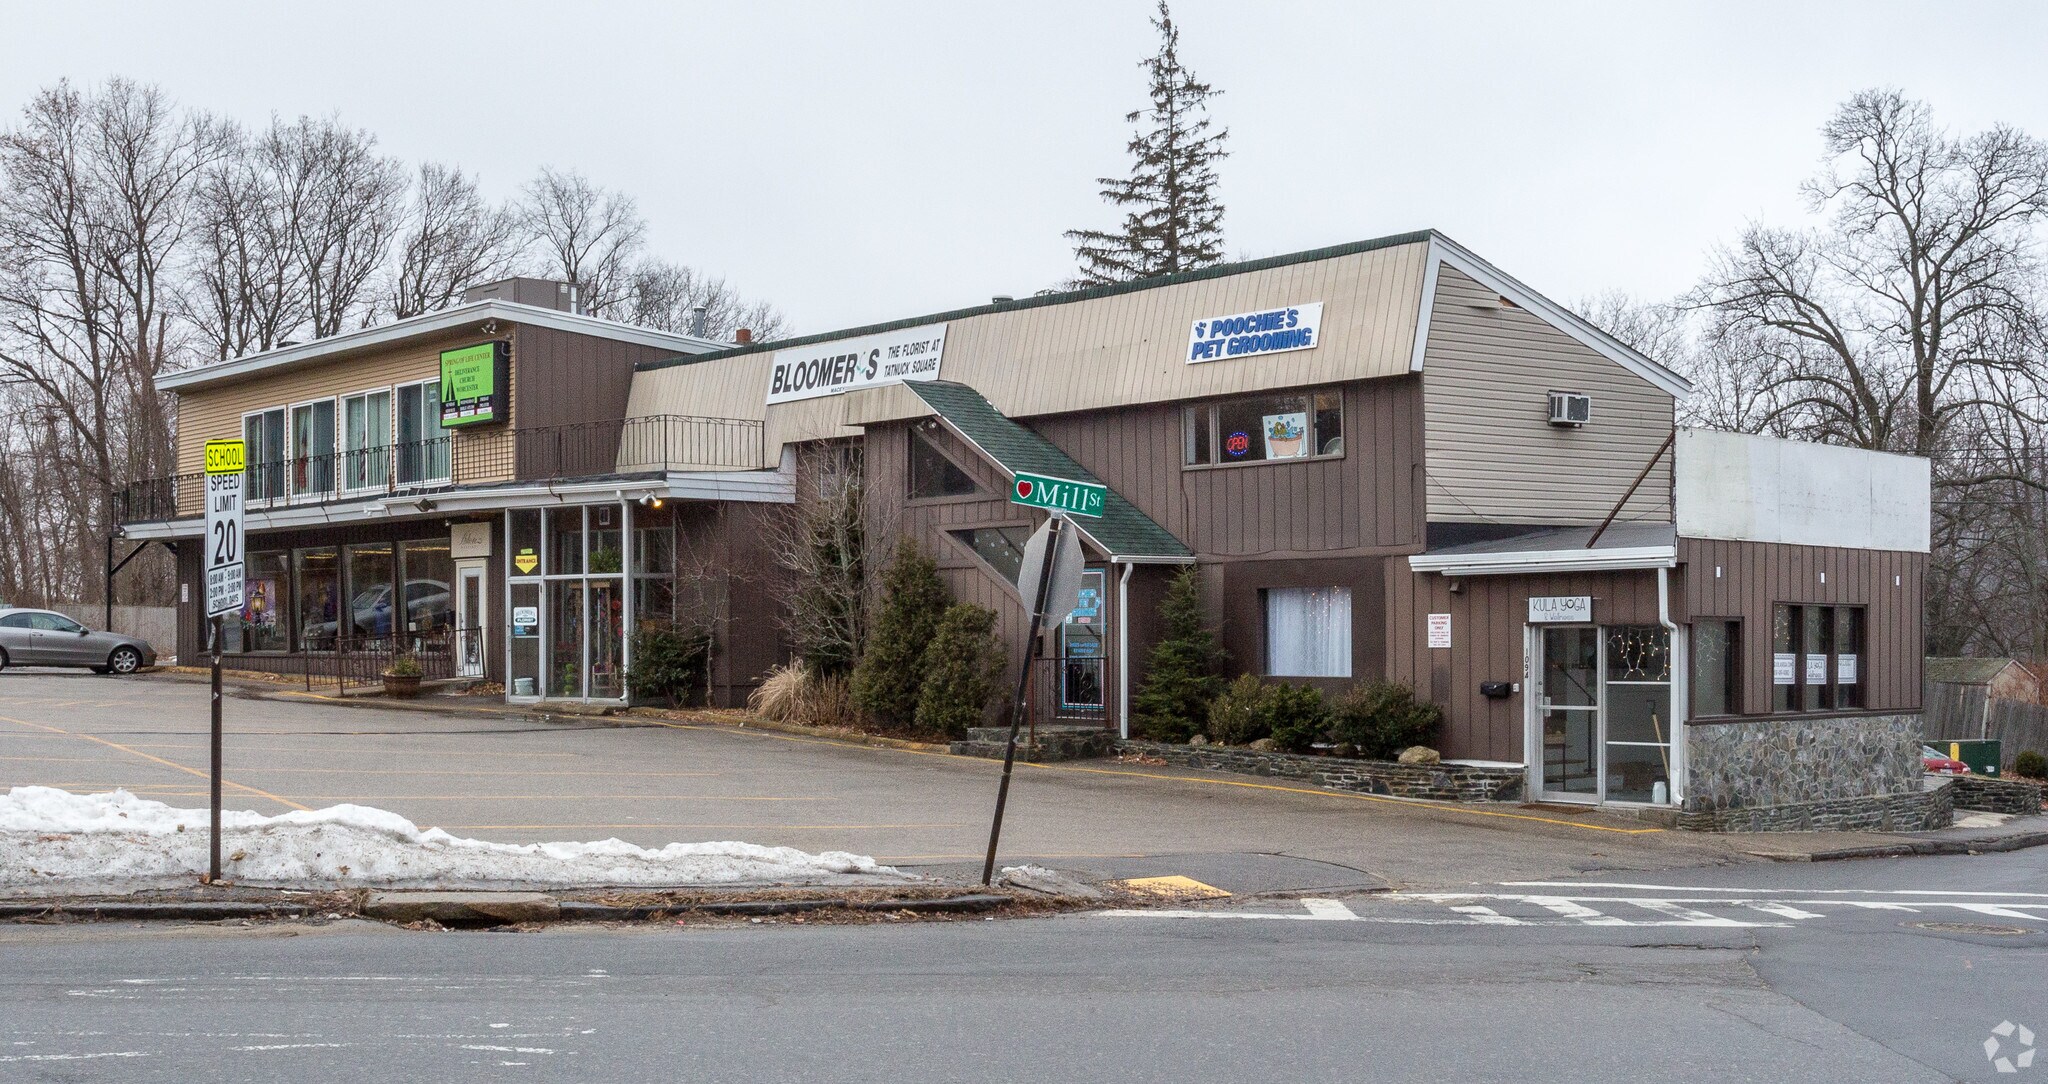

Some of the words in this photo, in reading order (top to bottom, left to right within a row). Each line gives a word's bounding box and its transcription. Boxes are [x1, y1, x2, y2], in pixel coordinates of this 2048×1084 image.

[887, 346, 900, 359] THE
[902, 340, 930, 356] FLORIST
[931, 338, 941, 352] AT
[1191, 339, 1226, 360] PET
[1227, 327, 1313, 356] GROOMING
[445, 358, 459, 366] SPRING
[465, 355, 474, 363] LIFE
[475, 352, 491, 360] CENTER
[455, 366, 480, 376] DELIVERANCE
[884, 361, 910, 378] TATNUCK
[911, 358, 937, 373] SQUARE
[456, 384, 478, 392] WORCESTER
[1227, 436, 1248, 450] OPEN
[208, 448, 242, 467] SCHOOL
[211, 473, 240, 491] SPEED
[215, 494, 237, 513] LIMIT
[1034, 481, 1088, 511] Mill
[1089, 493, 1101, 507] St
[214, 518, 236, 566] 20
[218, 572, 224, 583] AM
[236, 567, 241, 579] AM
[218, 584, 224, 596] PM
[236, 580, 241, 591] PM
[212, 597, 227, 609] SCHOOL
[228, 593, 239, 604] DAYS
[1533, 598, 1557, 611] KULA
[1560, 597, 1586, 612] YOGA
